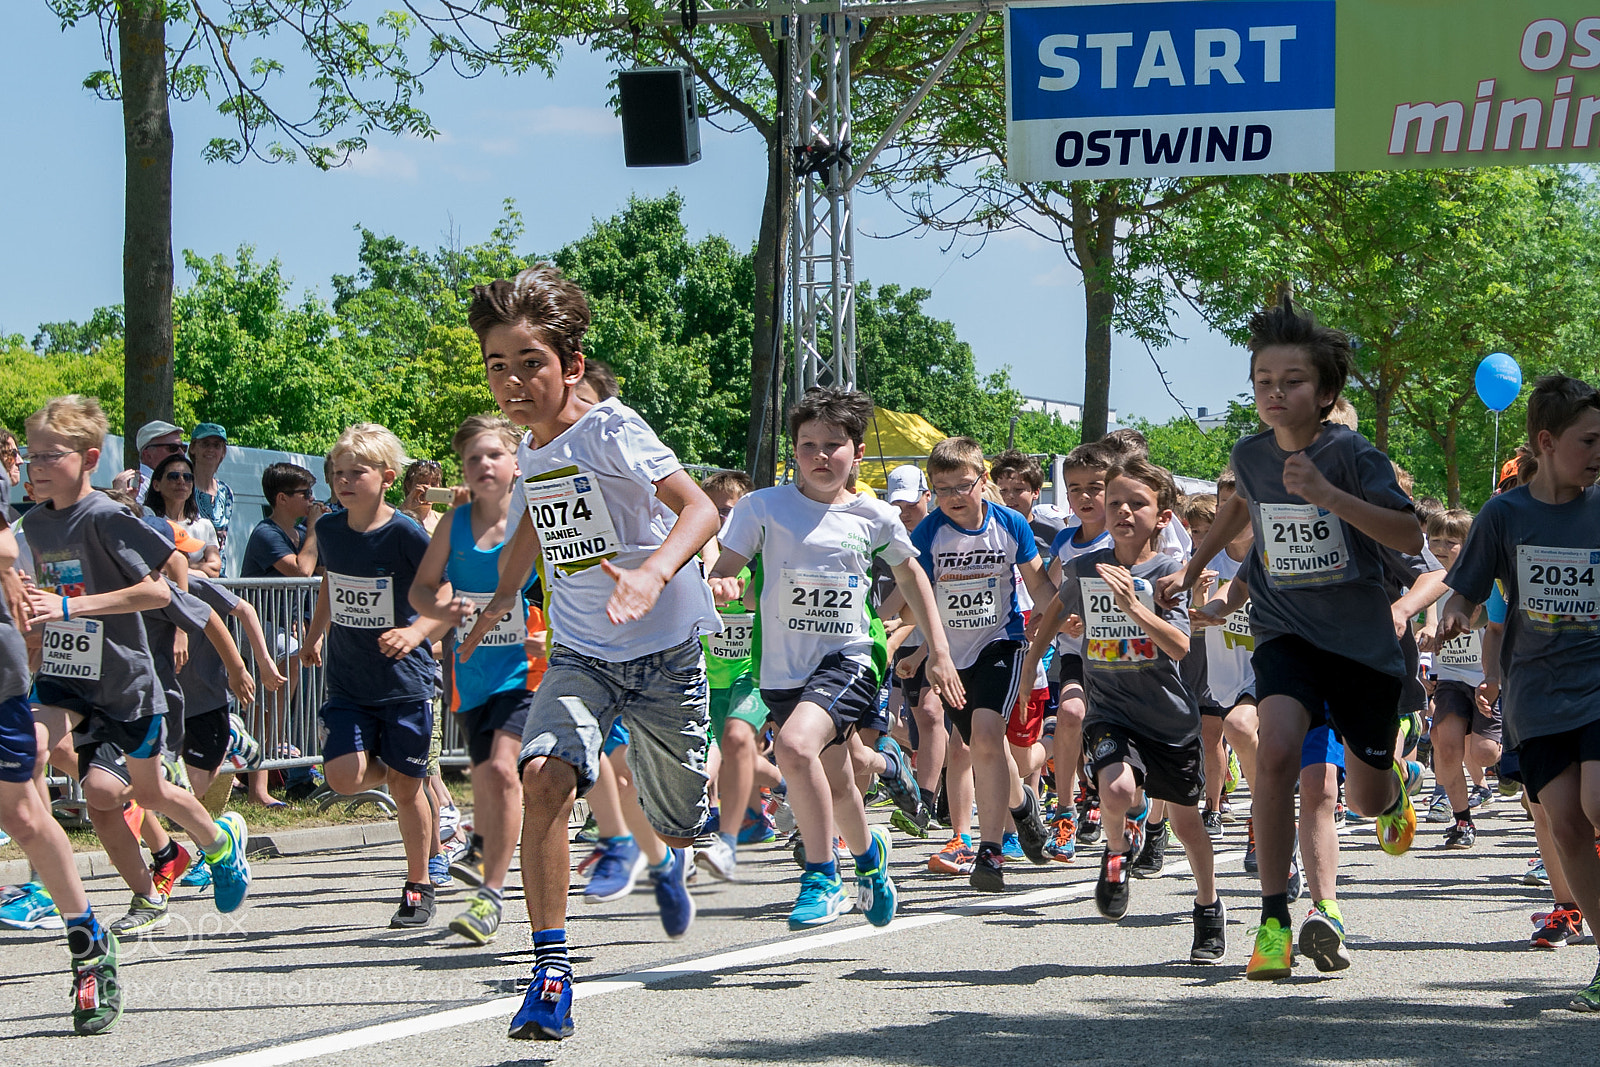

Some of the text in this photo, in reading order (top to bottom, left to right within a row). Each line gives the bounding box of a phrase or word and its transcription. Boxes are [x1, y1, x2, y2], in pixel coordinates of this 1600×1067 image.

[1519, 16, 1600, 72] os
[1037, 25, 1297, 92] START
[1054, 124, 1273, 168] OSTWIND
[532, 497, 593, 529] 2074
[544, 527, 582, 541] DANIEL
[1272, 520, 1330, 543] 2156
[543, 537, 606, 561] STWIND
[1289, 545, 1316, 554] FELIX
[1275, 551, 1340, 571] OSTWIND
[1530, 564, 1595, 587] 2034
[335, 587, 382, 607] 2067
[792, 587, 853, 609] 2122
[1543, 587, 1579, 596] SIMON
[948, 590, 994, 610] 2043
[1528, 597, 1596, 613] OSTWIND
[344, 606, 370, 615] JONAS
[805, 608, 839, 618] JAKOB
[956, 607, 989, 617] MARLON
[335, 612, 386, 626] OSTWIND
[788, 618, 854, 634] OSTWIND
[949, 614, 998, 628] OSTWIND
[1101, 615, 1127, 623] FELIX
[44, 630, 90, 653] 2086
[48, 651, 73, 660] ARNE
[1442, 655, 1478, 663] OSTWIND
